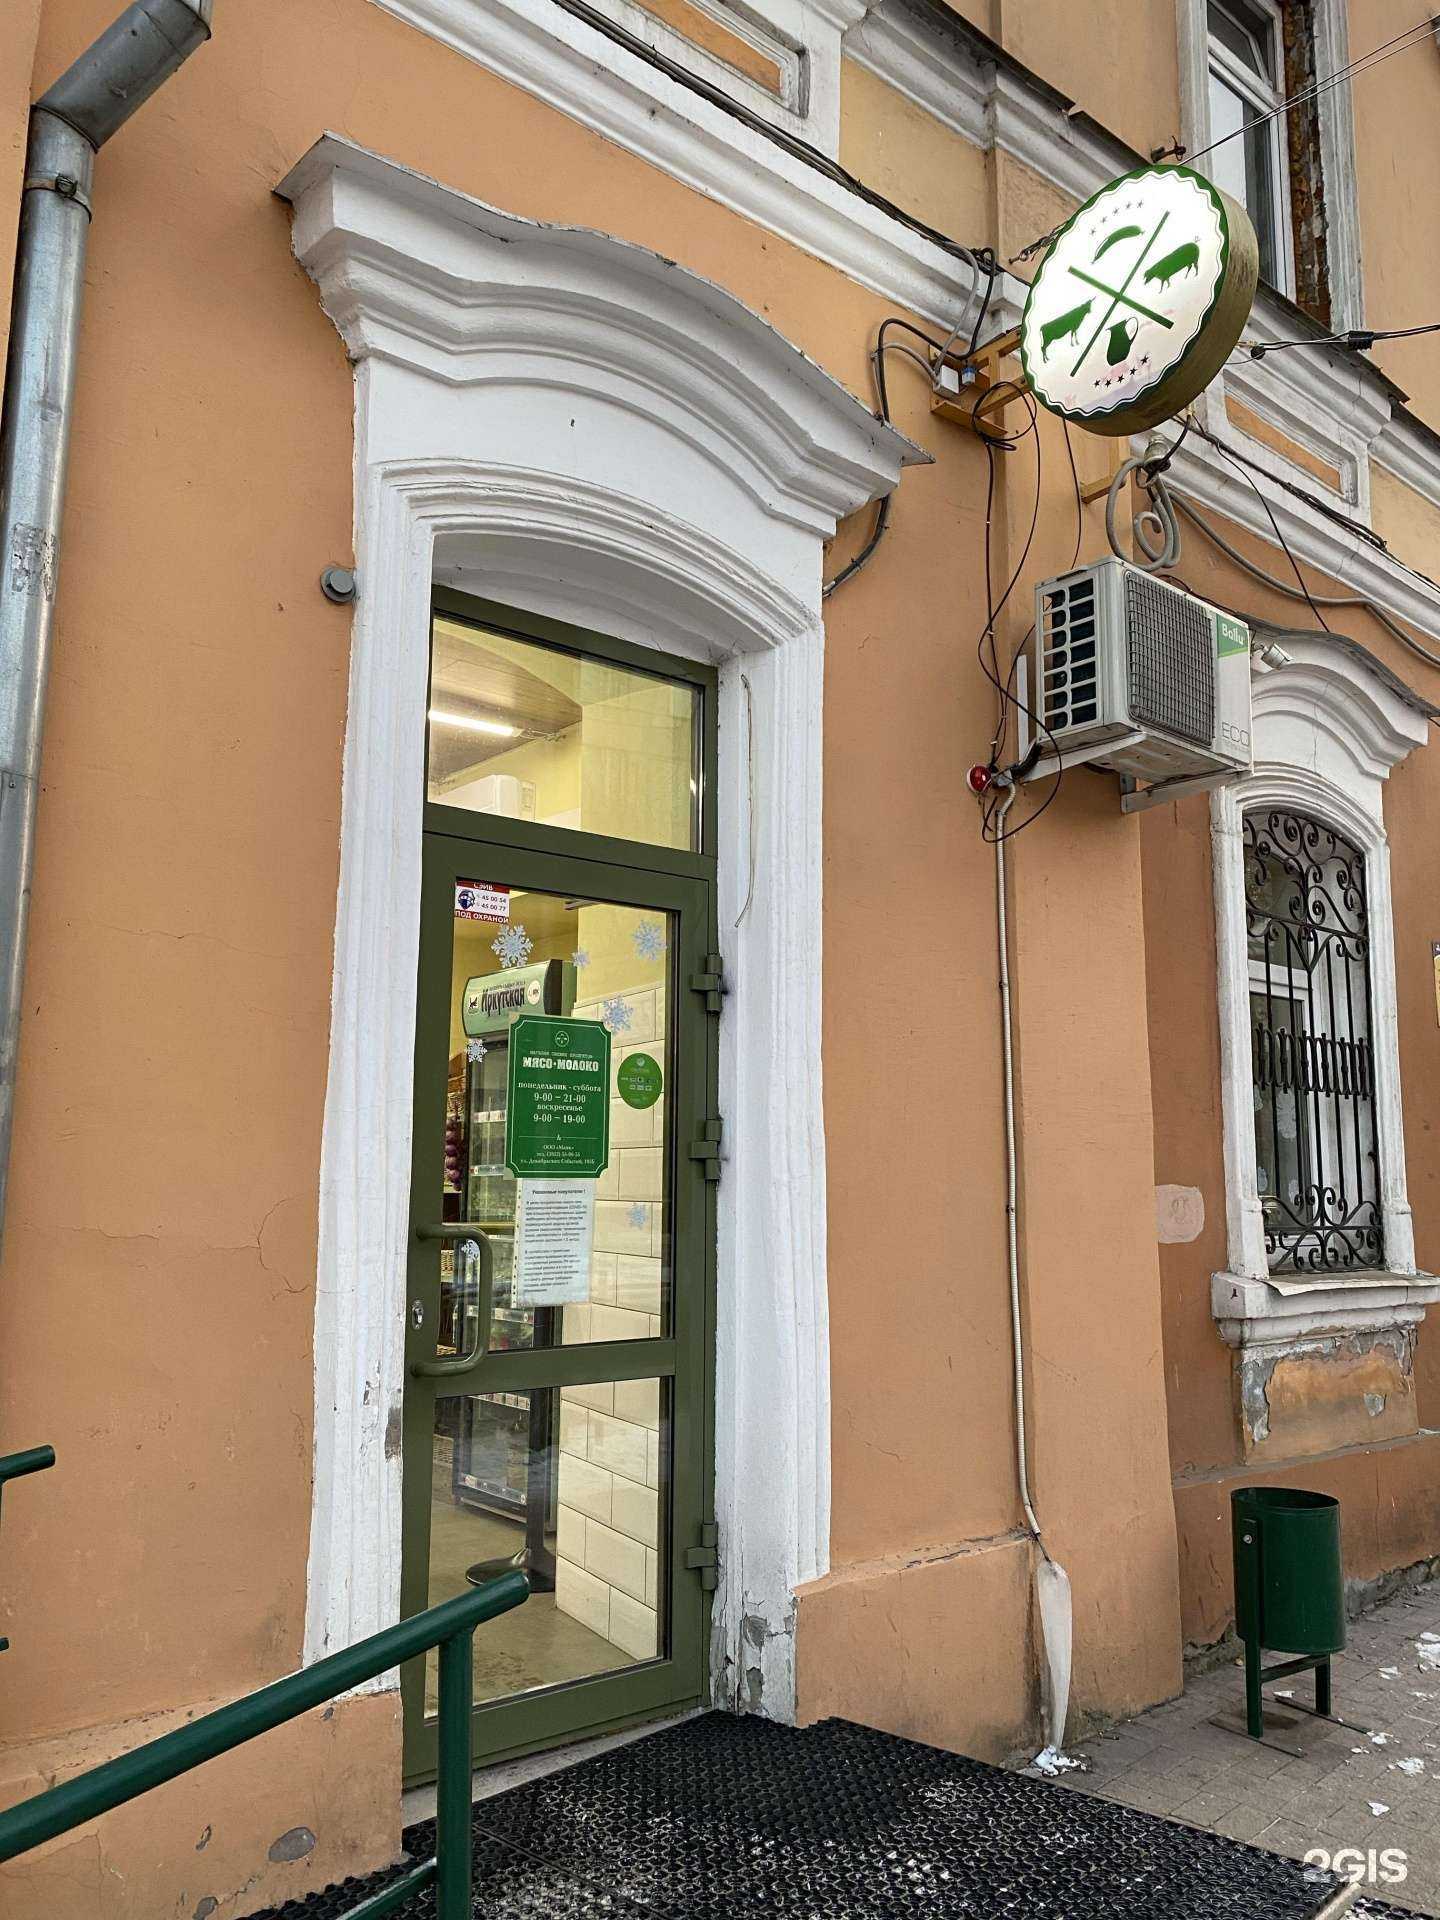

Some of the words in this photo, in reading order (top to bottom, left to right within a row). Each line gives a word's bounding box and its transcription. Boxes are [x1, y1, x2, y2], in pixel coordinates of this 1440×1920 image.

[1222, 624, 1244, 645] Ballu
[1222, 722, 1249, 746] ECO
[455, 911, 471, 920] ПОД
[518, 1082, 567, 1090] понедельник
[573, 1084, 601, 1092] суббота
[534, 1093, 552, 1101] 9-00
[563, 1094, 586, 1103] 21-00
[537, 1104, 583, 1112] воскресенье
[533, 1113, 552, 1122] 9-00
[563, 1115, 586, 1123] 19-00
